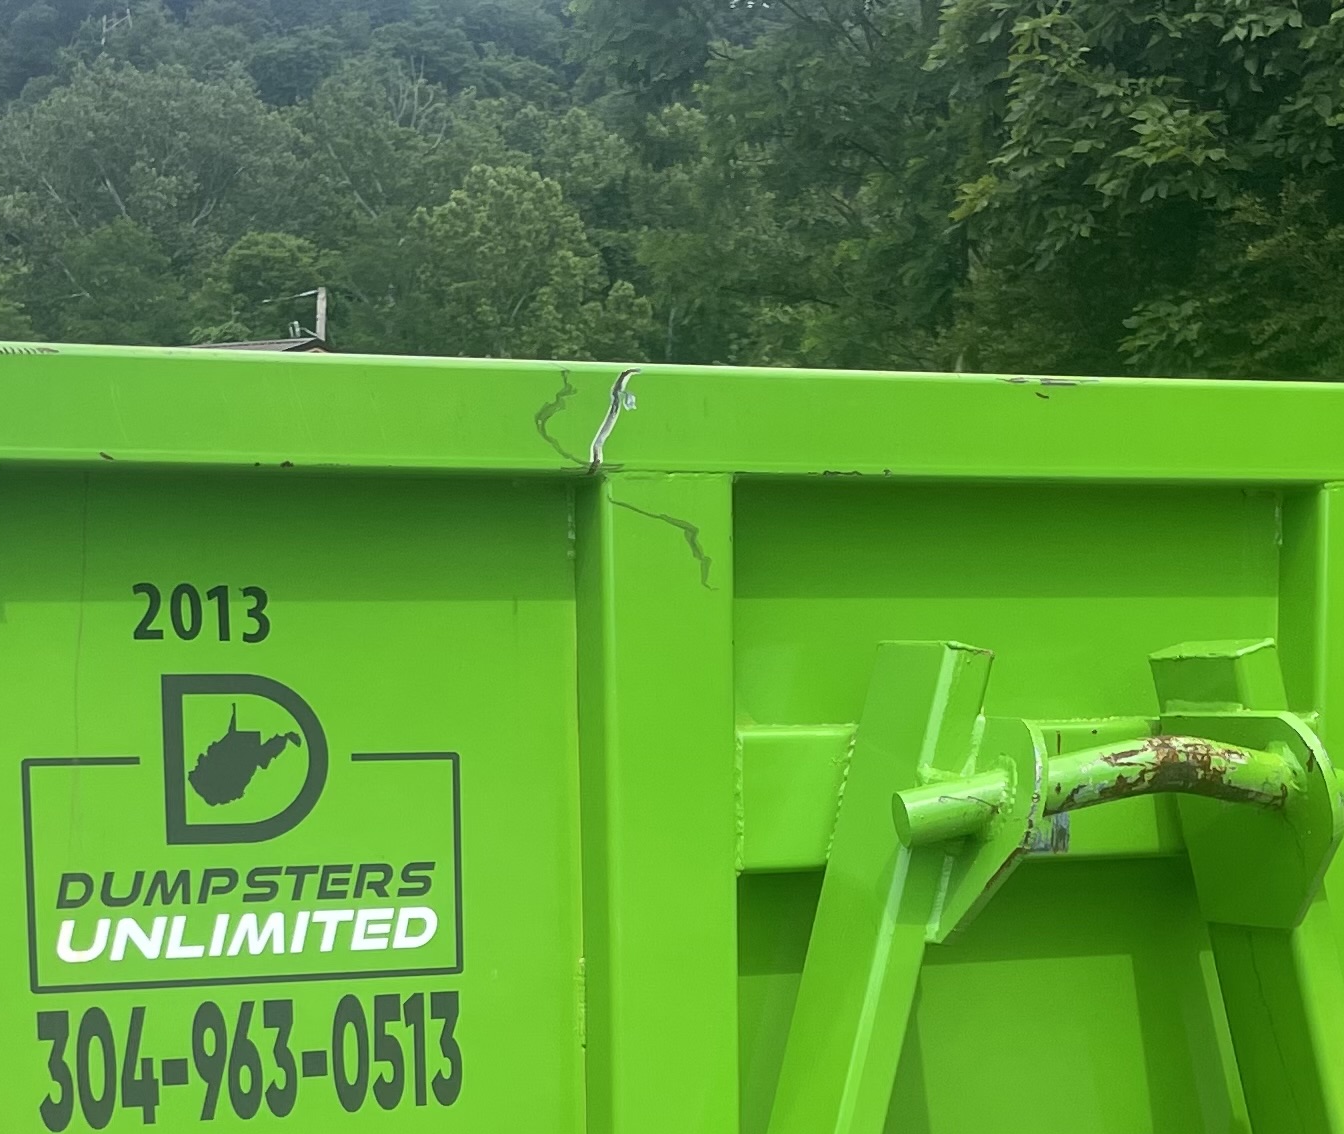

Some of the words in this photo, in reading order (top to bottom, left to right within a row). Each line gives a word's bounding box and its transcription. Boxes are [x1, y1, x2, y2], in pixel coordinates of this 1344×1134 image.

[132, 582, 271, 643] 2013
[161, 673, 329, 845] D
[56, 861, 436, 910] DUMPSTERS
[56, 906, 439, 963] UNLIMITED
[36, 990, 464, 1133] 304-963-0513
